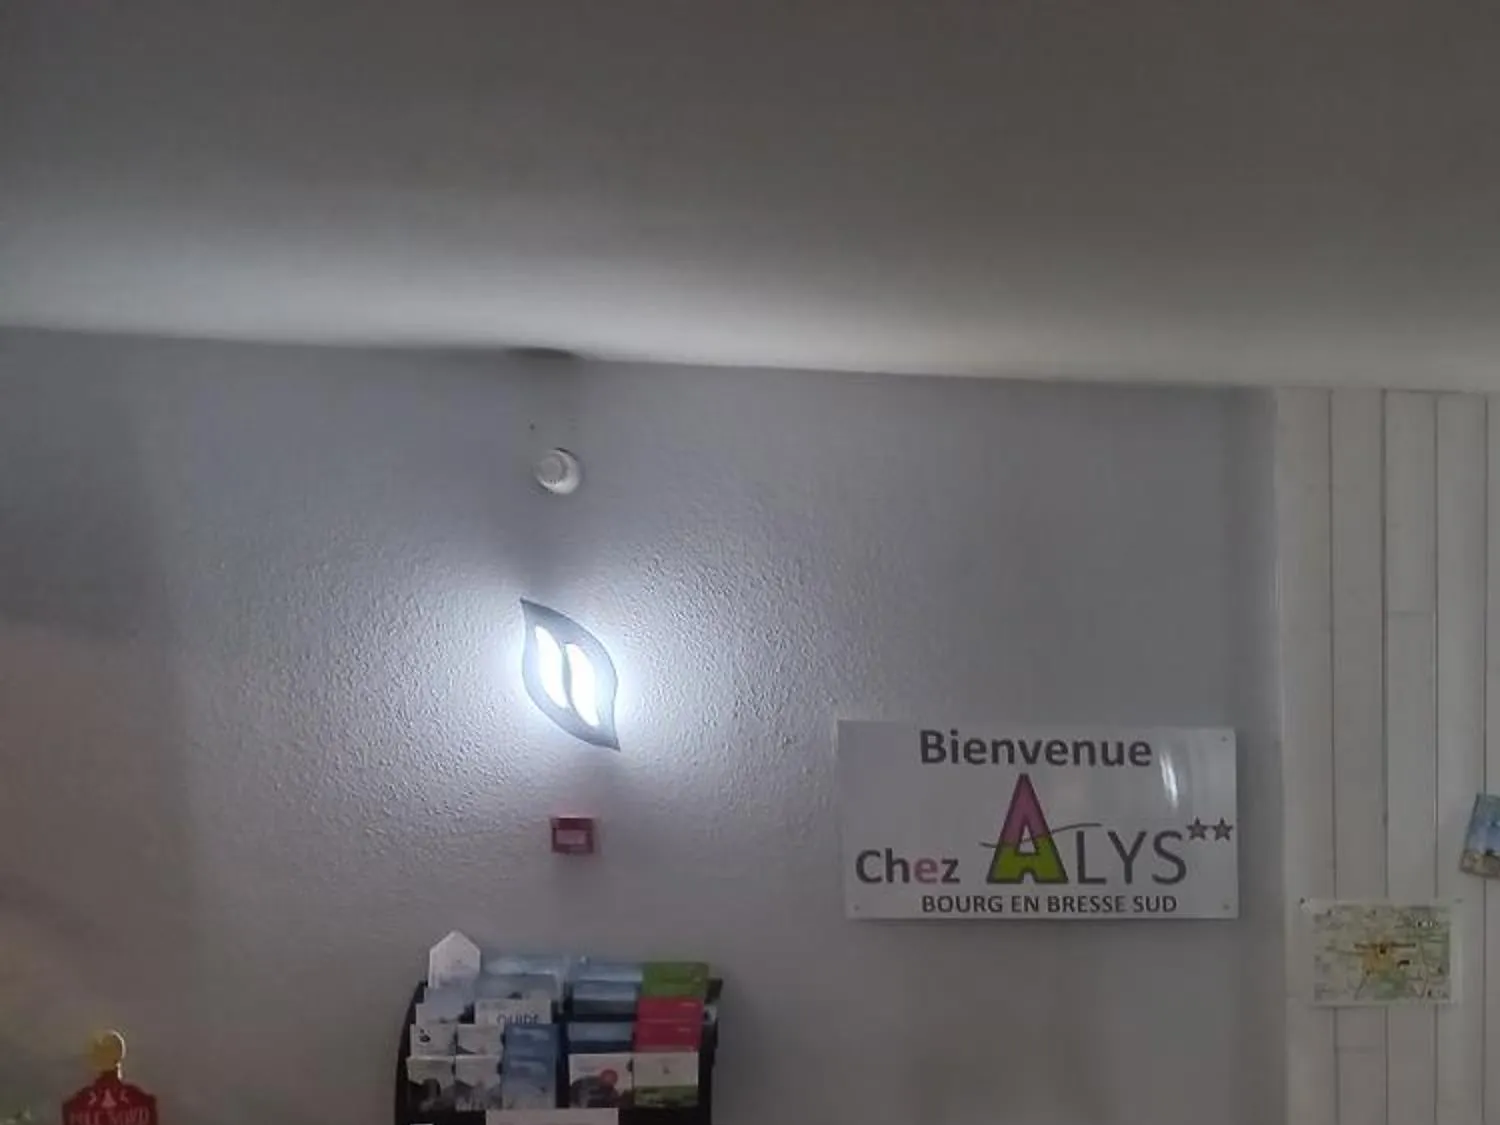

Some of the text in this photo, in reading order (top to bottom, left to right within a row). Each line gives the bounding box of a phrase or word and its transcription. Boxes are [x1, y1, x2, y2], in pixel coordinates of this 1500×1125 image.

[920, 729, 1152, 767] Bienvenue
[855, 773, 1188, 885] Chez ALYS
[921, 895, 1178, 914] BOURG EN BRESSE SUD
